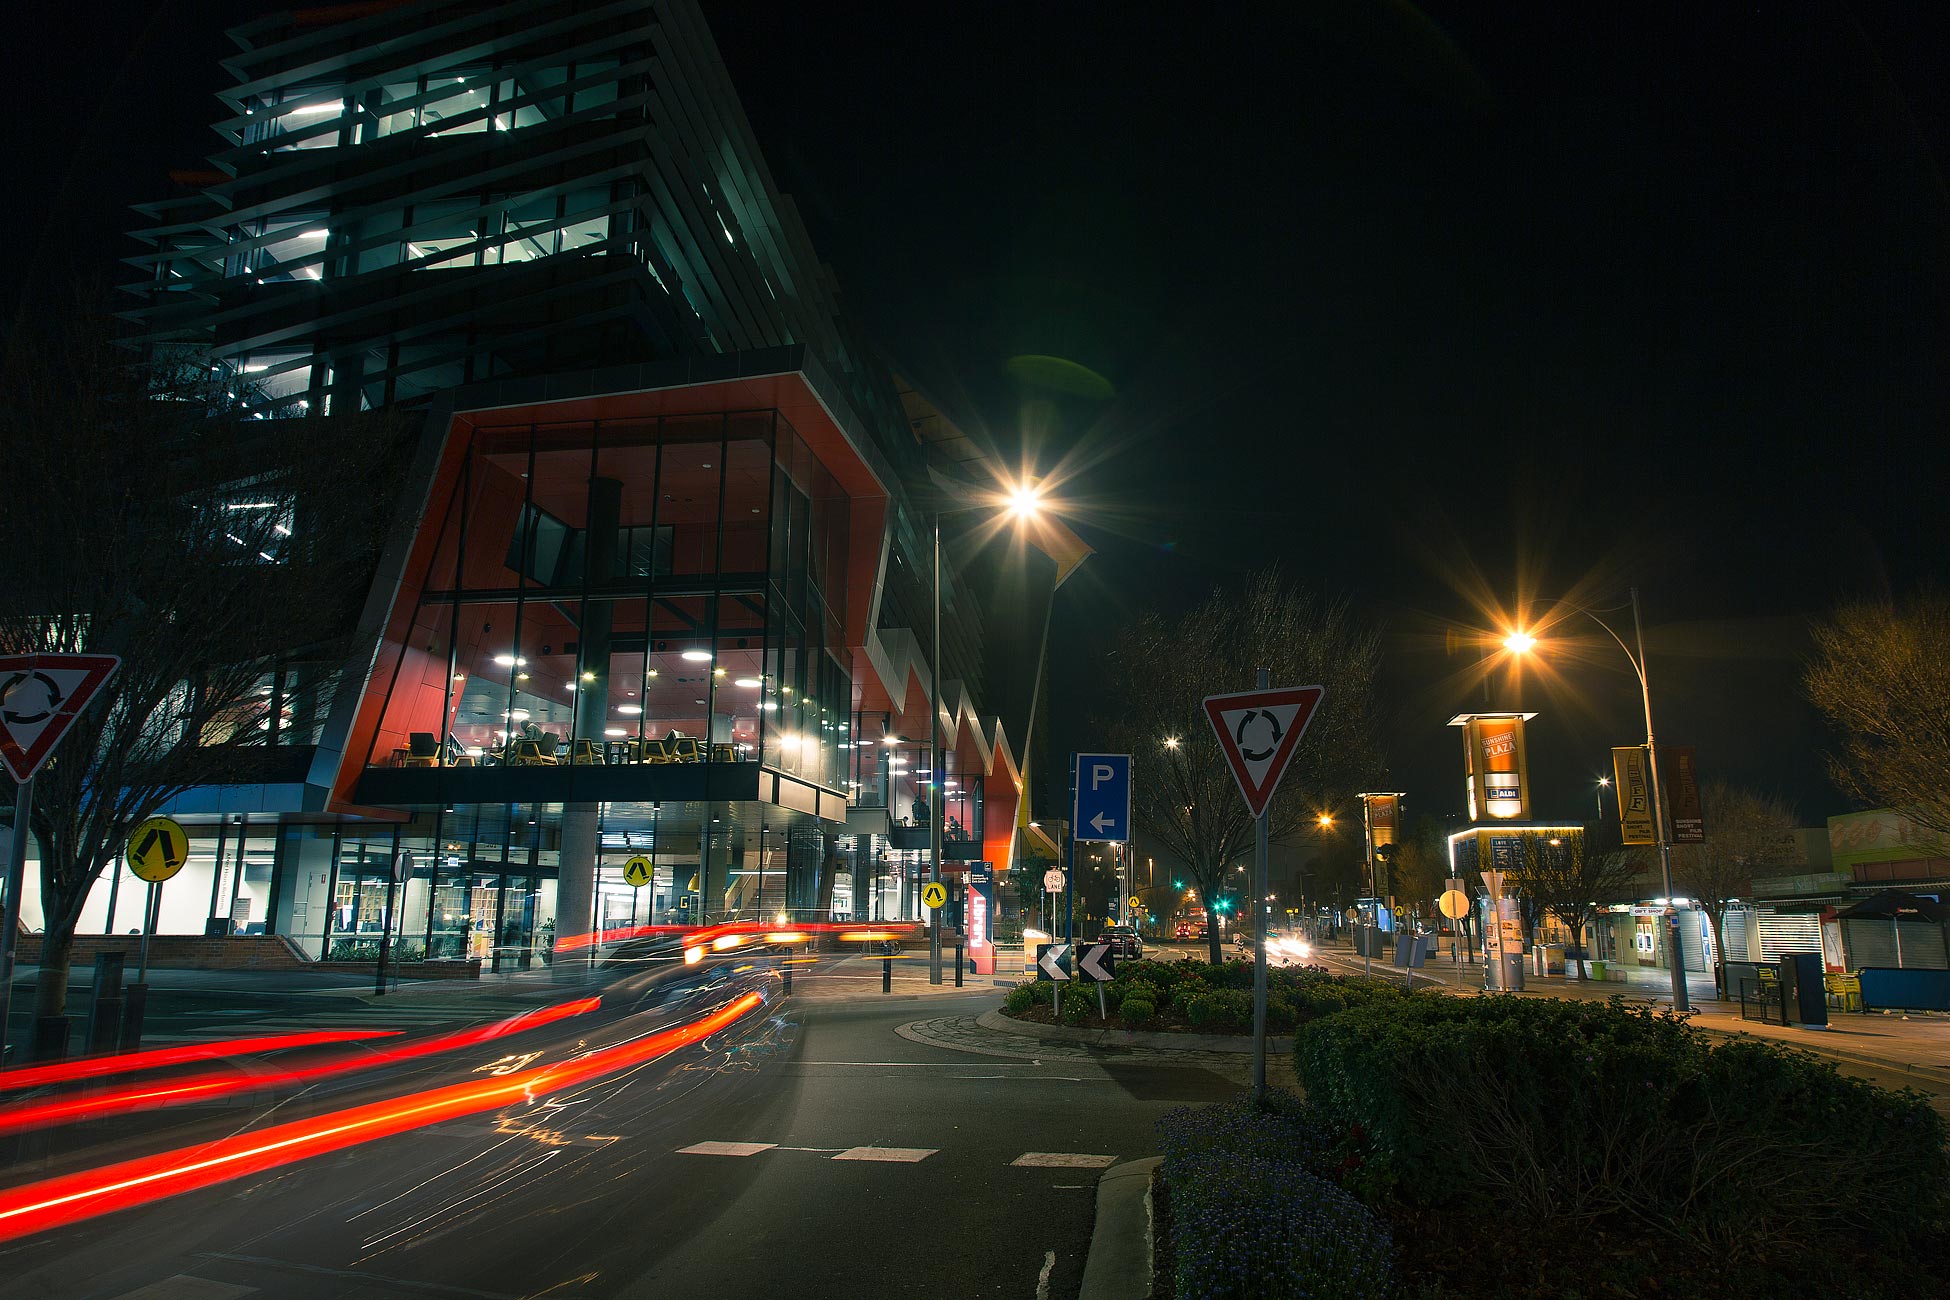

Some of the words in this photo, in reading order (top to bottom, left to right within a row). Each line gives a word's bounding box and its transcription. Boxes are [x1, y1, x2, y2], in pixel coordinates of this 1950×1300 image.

[1482, 733, 1513, 746] SUNSHINE
[1484, 741, 1516, 757] PLAZA
[1092, 764, 1115, 791] P
[1374, 809, 1394, 818] PLAZA
[680, 896, 688, 908] G
[970, 896, 986, 948] Library
